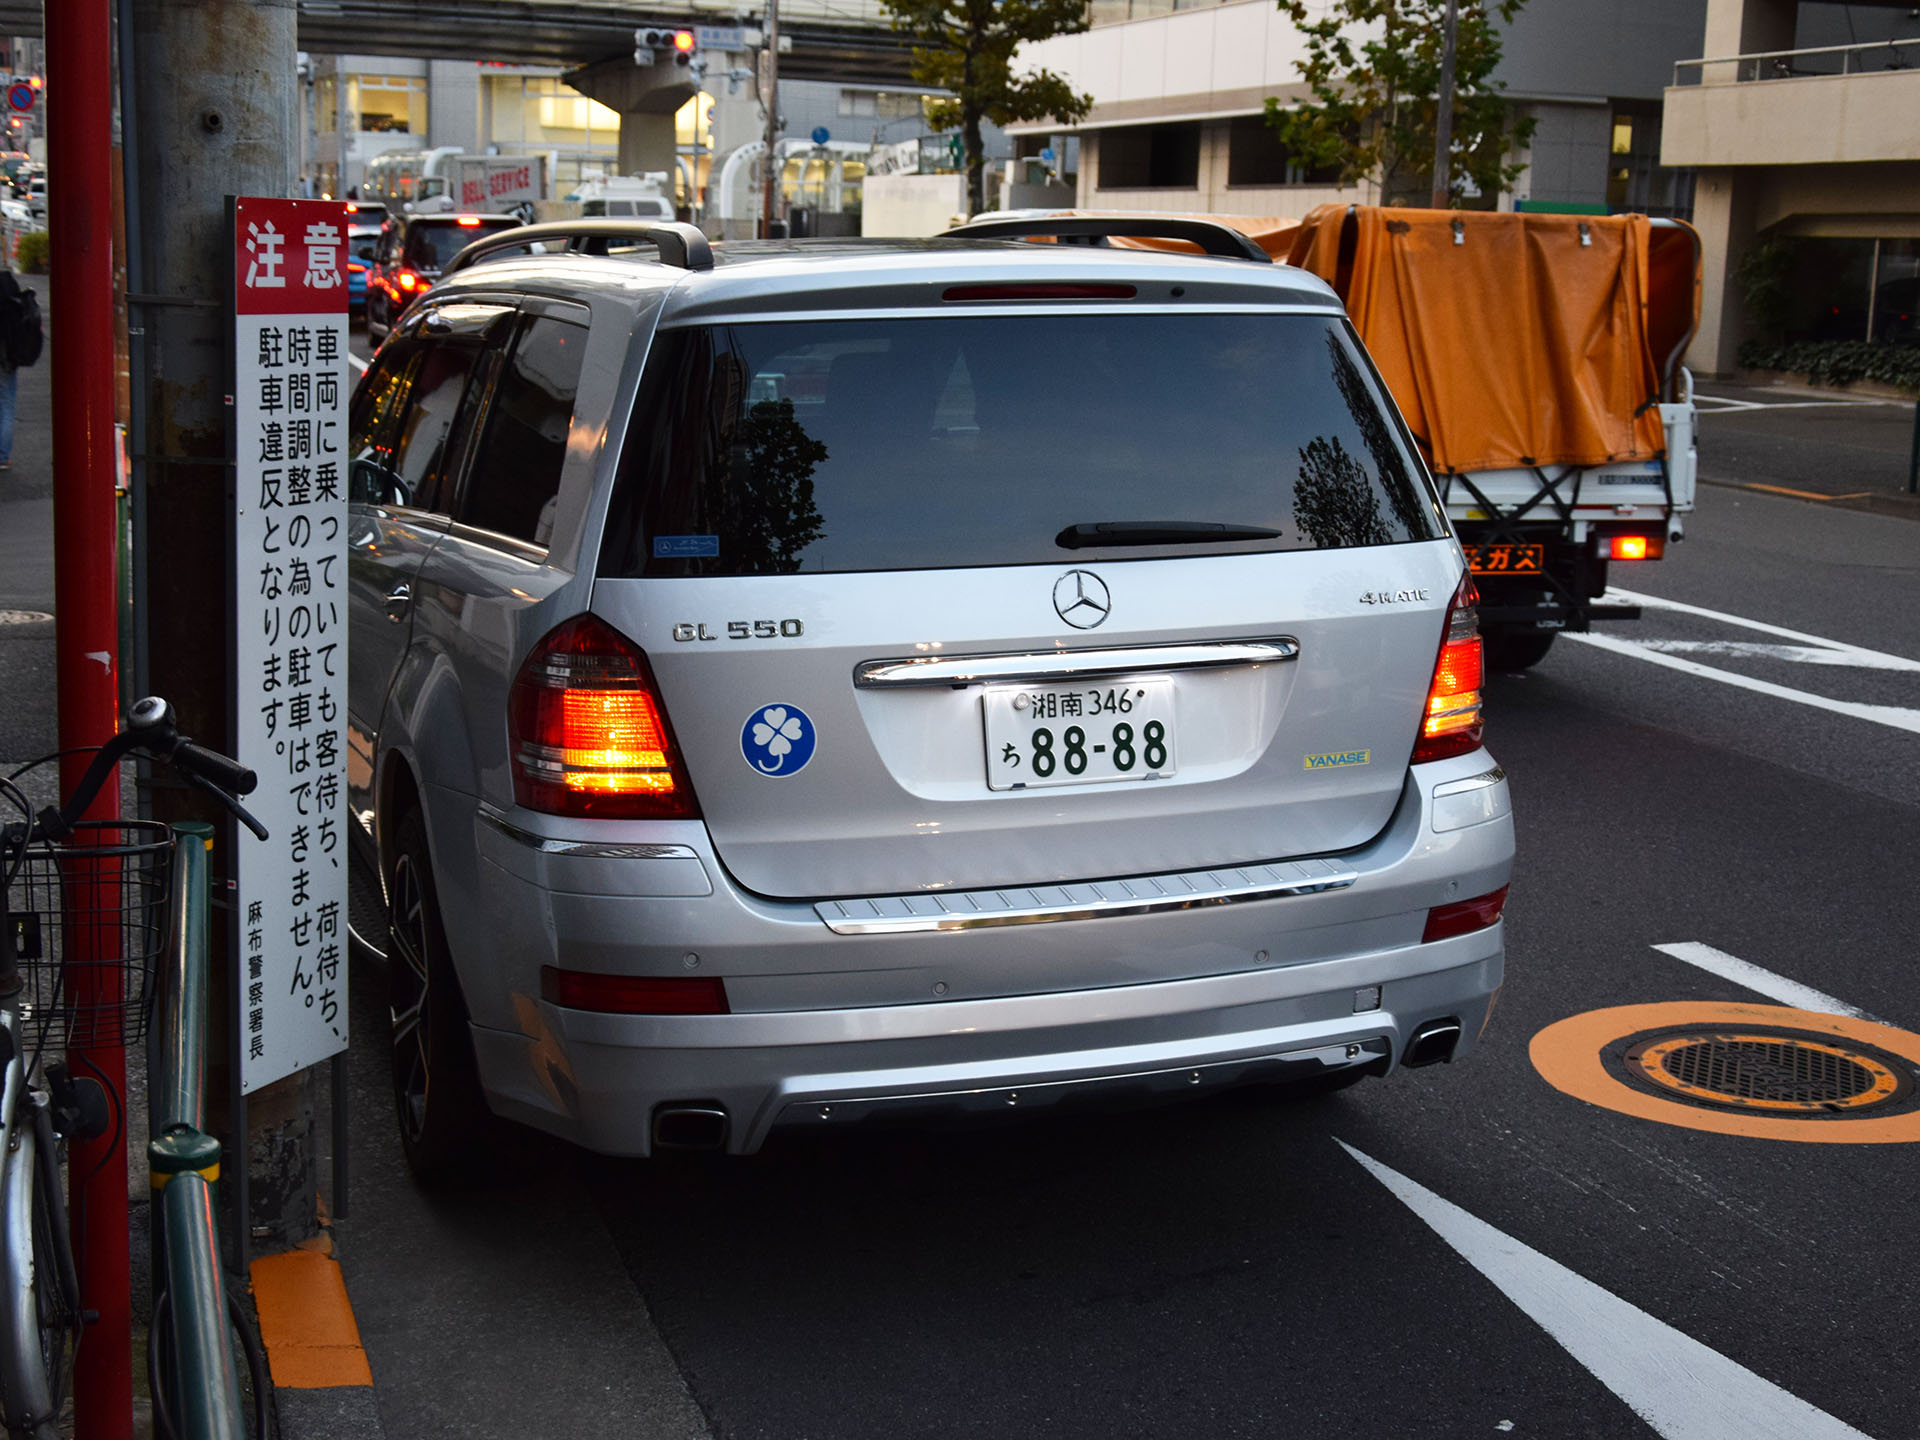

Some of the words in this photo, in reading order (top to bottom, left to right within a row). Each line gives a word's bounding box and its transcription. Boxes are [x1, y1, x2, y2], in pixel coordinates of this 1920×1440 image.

[245, 219, 342, 289] 注意
[259, 326, 285, 756] 駐車違反となります。
[287, 325, 314, 1008] 時間調整の為の駐車はできません。
[673, 623, 718, 642] GL
[728, 618, 804, 640] 550
[1308, 751, 1367, 768] YANASE
[248, 900, 264, 1060] 麻布警察署長
